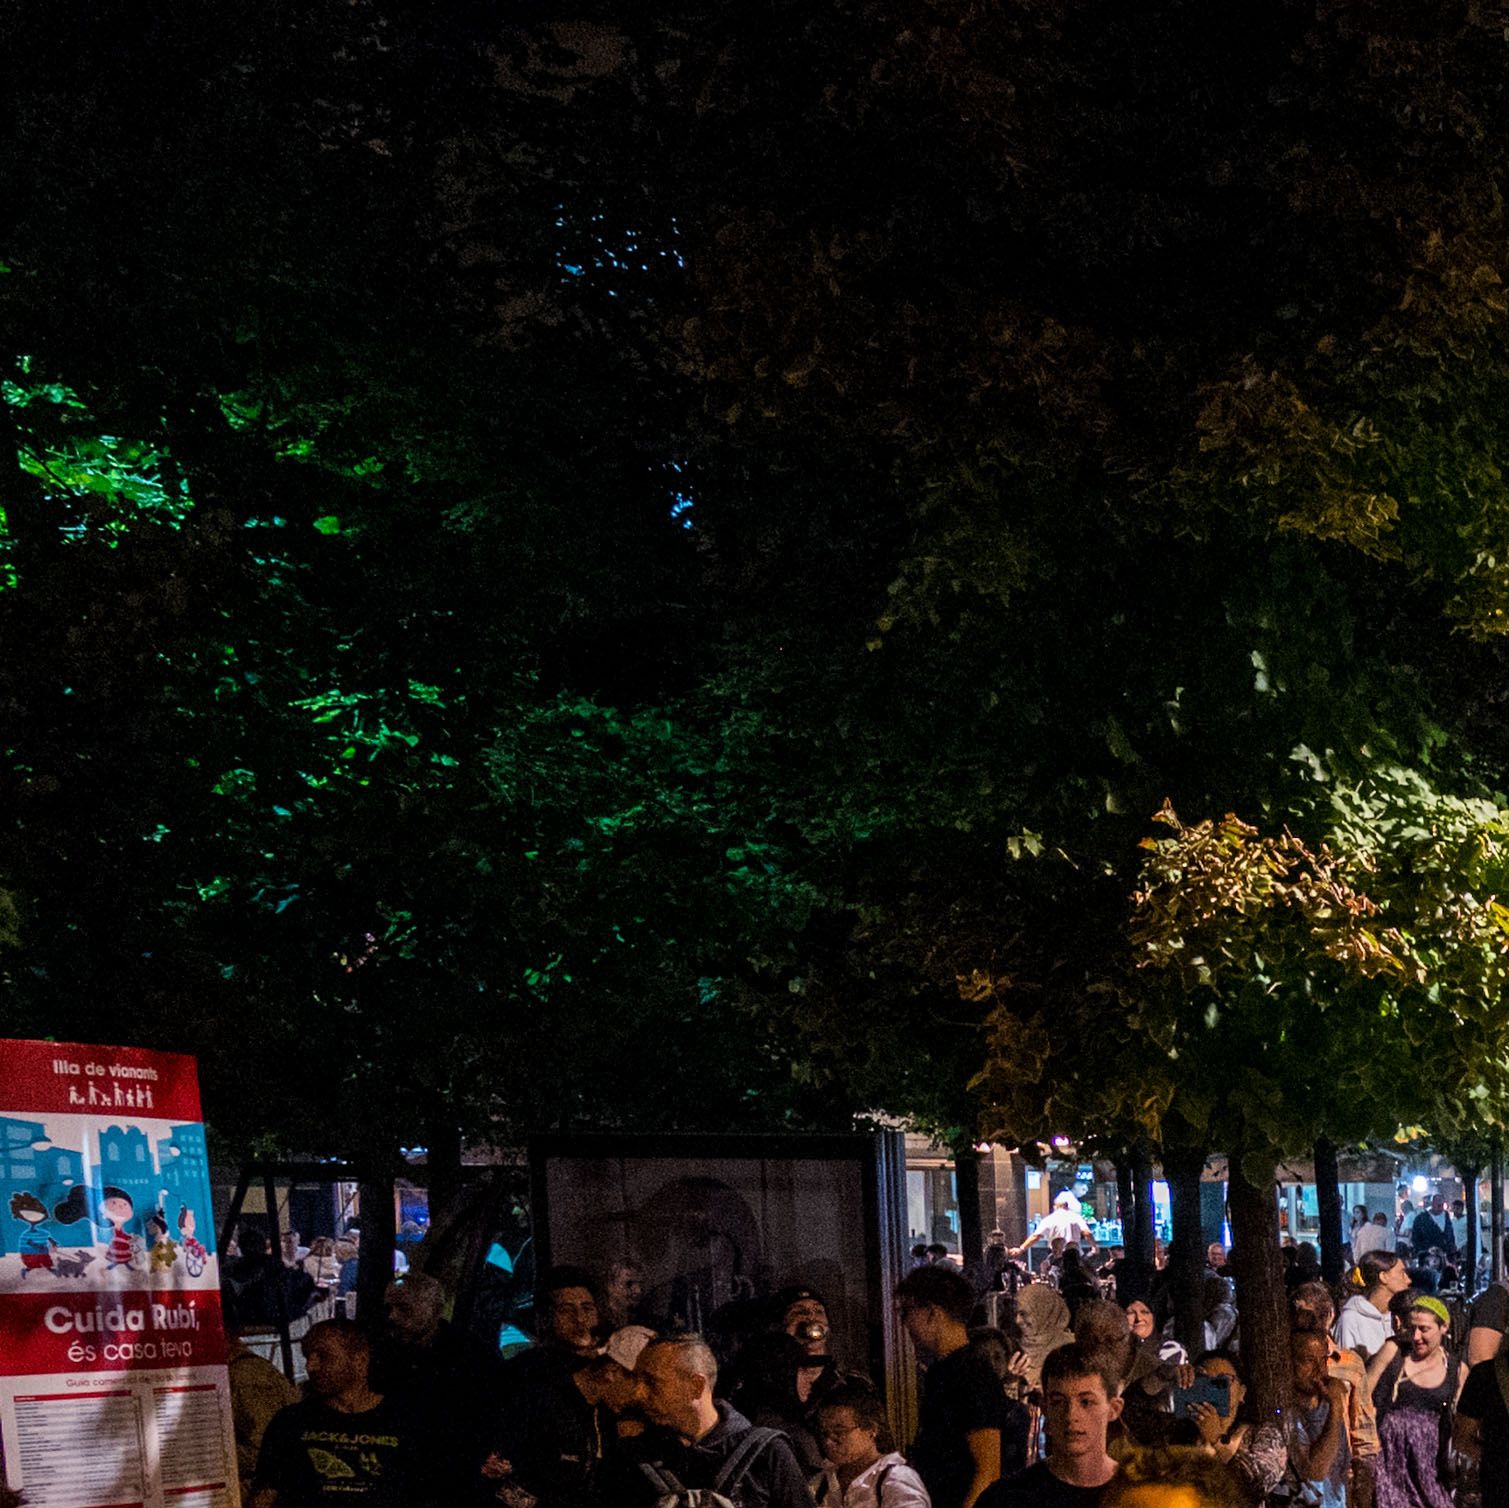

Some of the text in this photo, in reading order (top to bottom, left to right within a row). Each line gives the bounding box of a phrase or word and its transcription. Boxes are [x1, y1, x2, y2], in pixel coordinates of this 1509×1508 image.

[53, 1059, 158, 1081] Illa de vianants
[44, 1300, 200, 1334] Cuida Rubí,
[67, 1340, 97, 1362] és
[103, 1343, 157, 1362] casa
[65, 1377, 90, 1387] Guia
